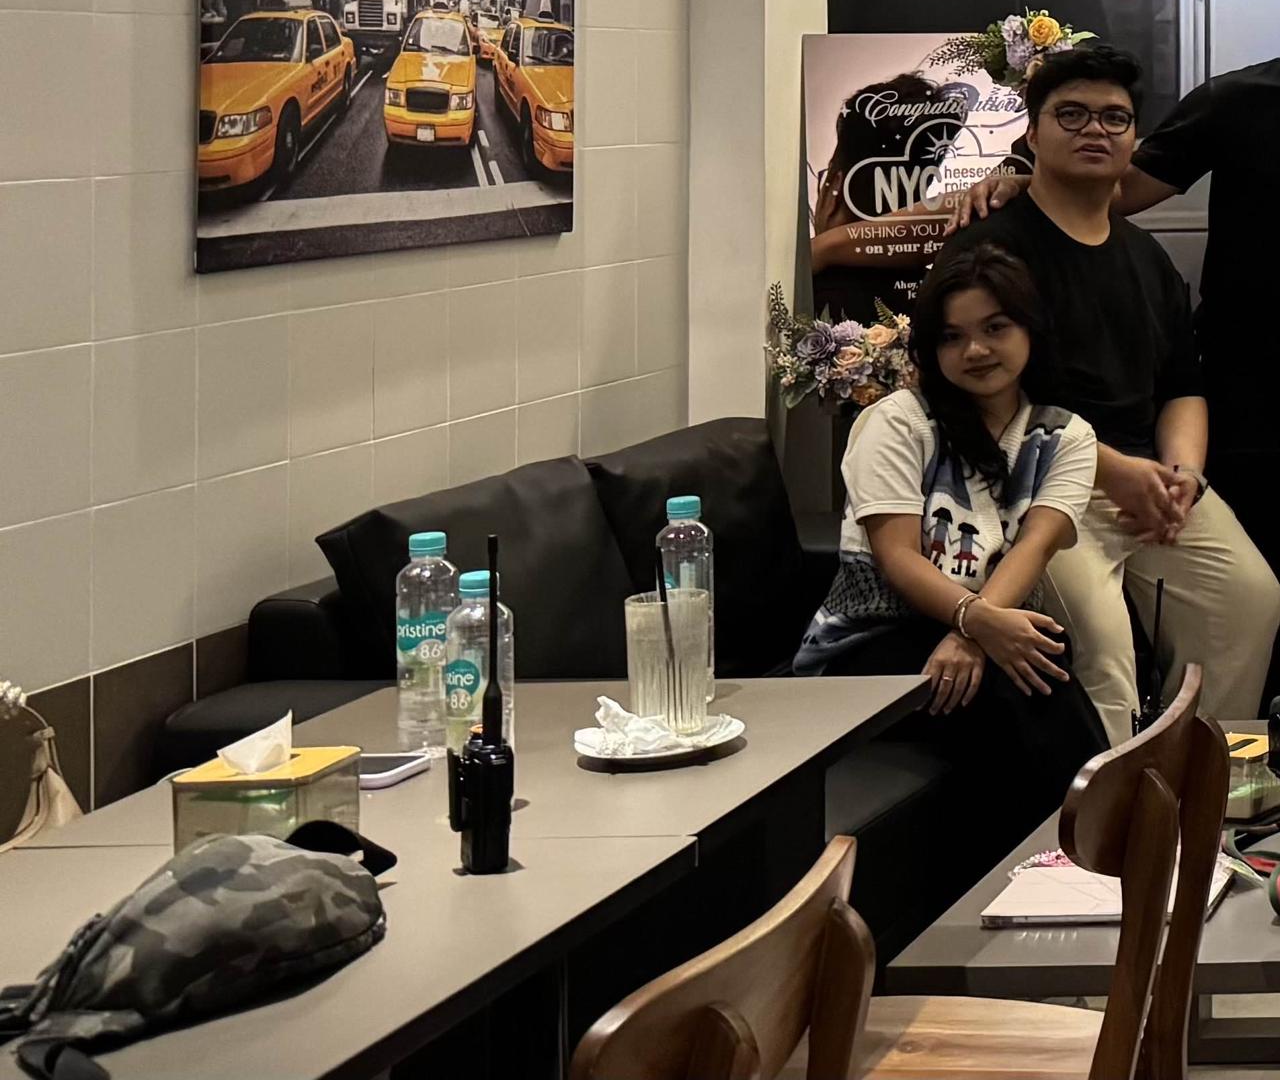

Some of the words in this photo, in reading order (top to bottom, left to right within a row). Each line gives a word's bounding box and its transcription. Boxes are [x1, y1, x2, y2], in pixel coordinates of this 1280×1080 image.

[873, 165, 943, 214] NYC
[847, 225, 907, 239] WISHING
[911, 223, 939, 236] YOU
[865, 245, 884, 255] on
[887, 243, 920, 256] your
